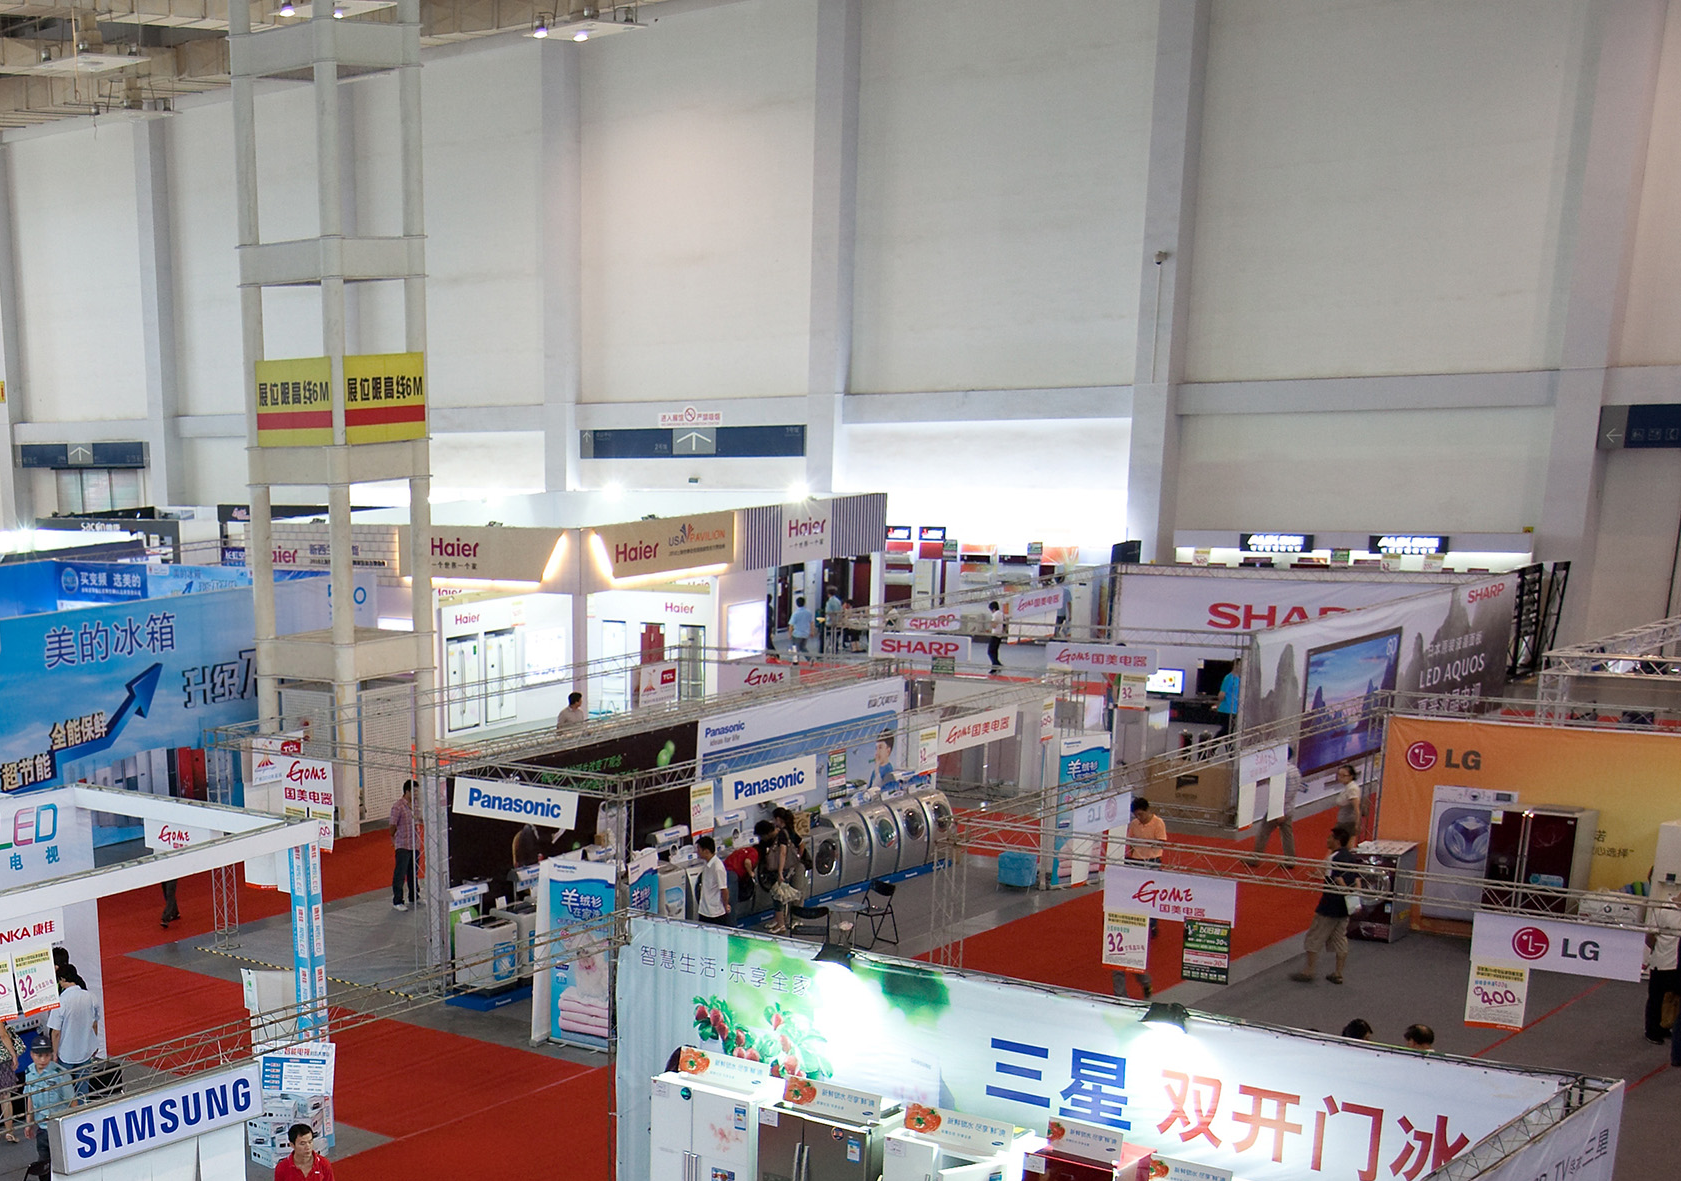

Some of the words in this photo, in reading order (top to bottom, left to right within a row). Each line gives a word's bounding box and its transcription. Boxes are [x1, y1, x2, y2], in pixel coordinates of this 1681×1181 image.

[669, 534, 686, 547] USA
[690, 529, 726, 541] PAVILION
[788, 519, 826, 538] Haier
[431, 538, 479, 558] Haier
[615, 542, 659, 564] Haier
[431, 561, 477, 570] 一个世界一个家
[80, 571, 107, 587] 买变频
[113, 573, 141, 588] 选美的
[1034, 594, 1060, 608] 国美电器
[1468, 582, 1505, 604] SHARP
[665, 602, 694, 614] Haier
[455, 613, 480, 625] Haier
[909, 614, 955, 630] SHARP
[44, 612, 176, 669] 美的冰箱
[881, 639, 959, 656] SHARP
[1091, 653, 1148, 667] 国美电器
[1419, 667, 1441, 688] LED
[1443, 653, 1485, 681] AQUOS
[1122, 687, 1132, 700] 32
[49, 711, 108, 751] 全能保鲜
[705, 721, 745, 738] Panasonic
[971, 716, 1010, 738] 国美电器
[732, 733, 740, 741] life
[1445, 749, 1481, 770] LG
[0, 753, 52, 792] 超节能
[734, 768, 805, 800] Panasonic
[285, 787, 333, 805] 国美电器
[469, 788, 561, 819] Panasonic
[561, 888, 602, 912] 羊绒衫
[1159, 904, 1205, 917] 国美电器
[32, 920, 56, 938] 康佳
[1107, 932, 1124, 952] 32
[1561, 938, 1600, 961] LG
[18, 975, 34, 999] 32
[1481, 990, 1516, 1006] 400
[985, 1037, 1132, 1132] 三星
[76, 1078, 251, 1159] SAMSUNG
